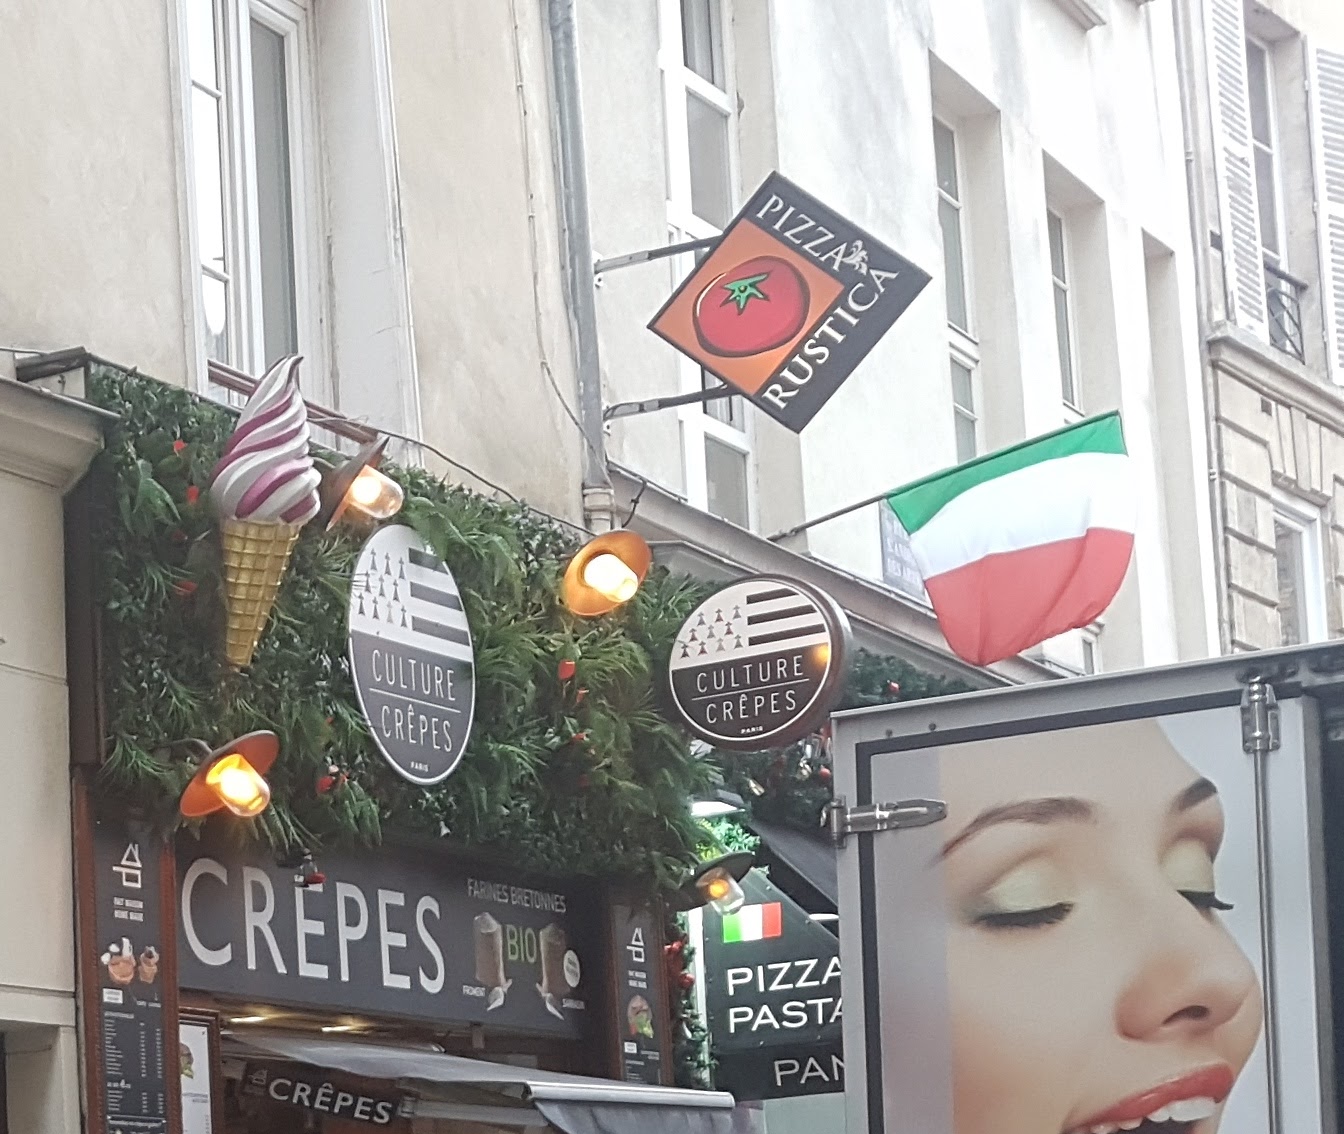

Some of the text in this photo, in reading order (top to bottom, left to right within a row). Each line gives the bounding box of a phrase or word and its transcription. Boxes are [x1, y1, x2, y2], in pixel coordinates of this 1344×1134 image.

[756, 194, 852, 272] PIZZA
[761, 268, 900, 410] RUSTICA
[370, 647, 457, 703] CULTURE
[695, 652, 806, 694] CULTURE
[705, 689, 798, 725] CRÊPES
[380, 703, 454, 755] CRÊPES
[467, 878, 509, 903] FARINES
[505, 923, 538, 964] BIO
[726, 955, 843, 997] PIZZA
[773, 1054, 846, 1087] PAN
[268, 1077, 393, 1125] CRÊPES
